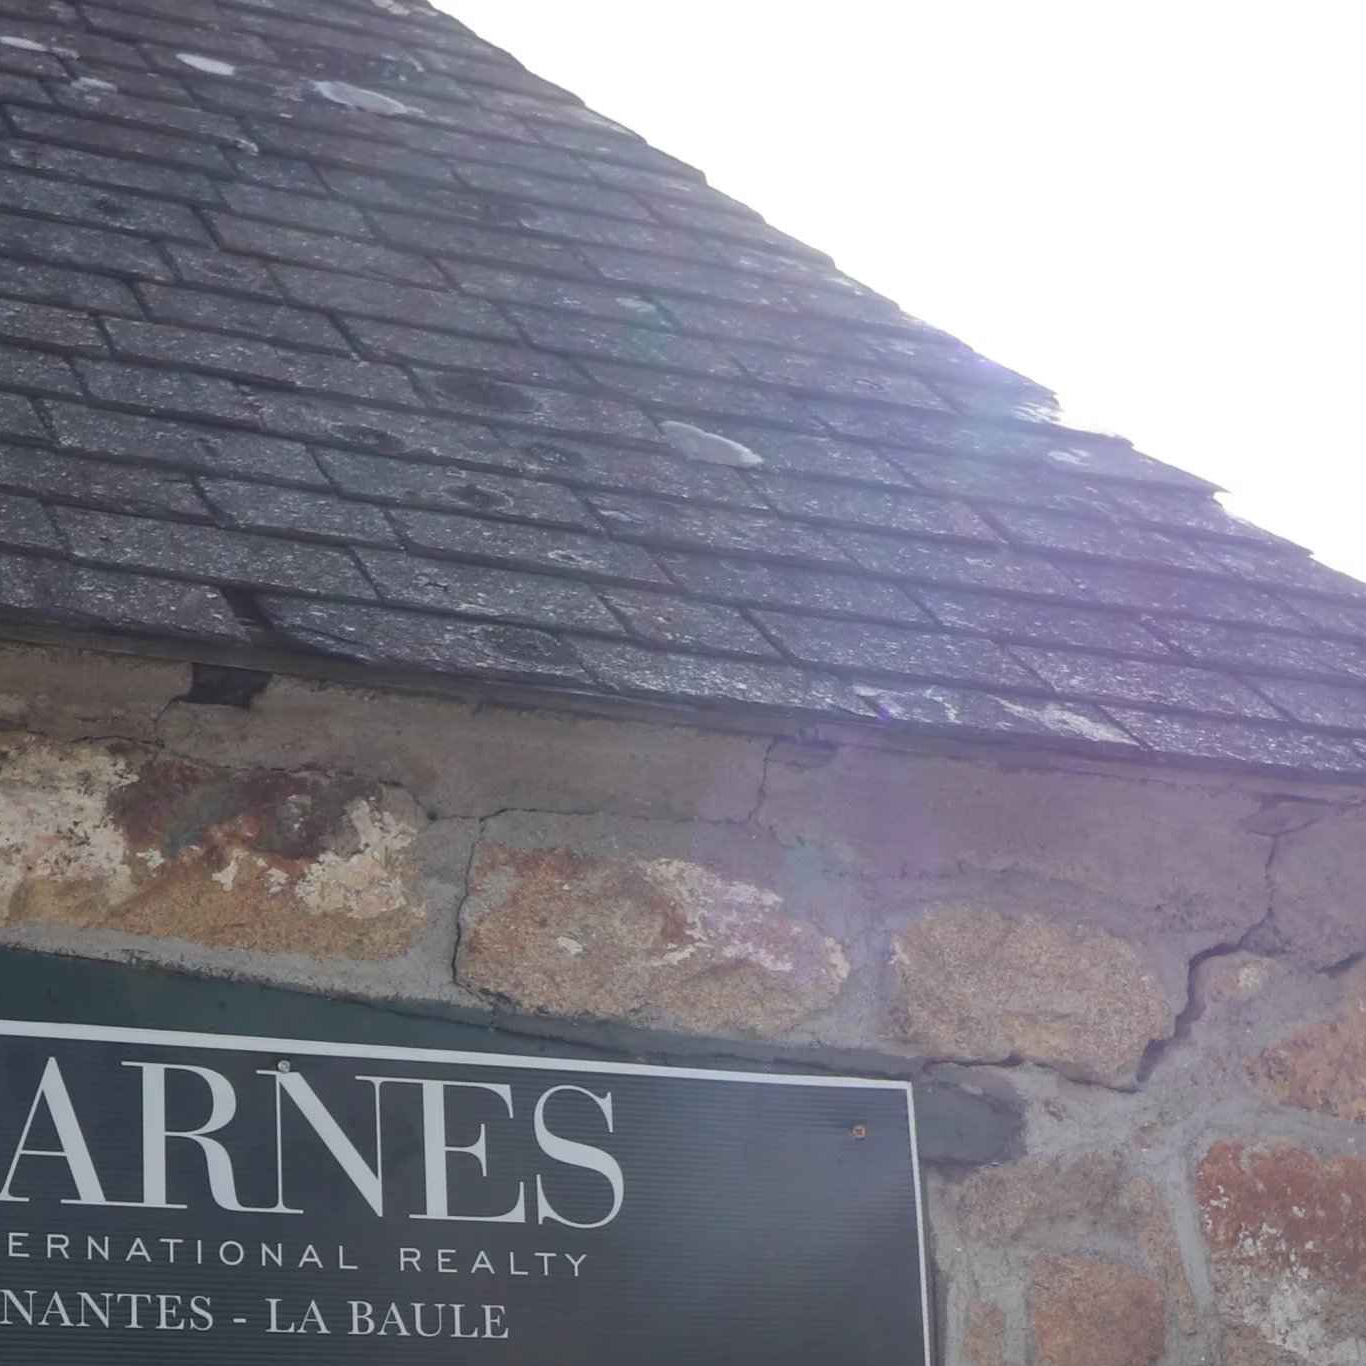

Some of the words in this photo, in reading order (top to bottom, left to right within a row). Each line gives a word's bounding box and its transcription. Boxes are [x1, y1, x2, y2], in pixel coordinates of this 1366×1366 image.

[400, 1246, 591, 1278] REALTY
[0, 1288, 214, 1332] NANTES
[265, 1298, 331, 1335] LA
[347, 1300, 510, 1340] BAULE
